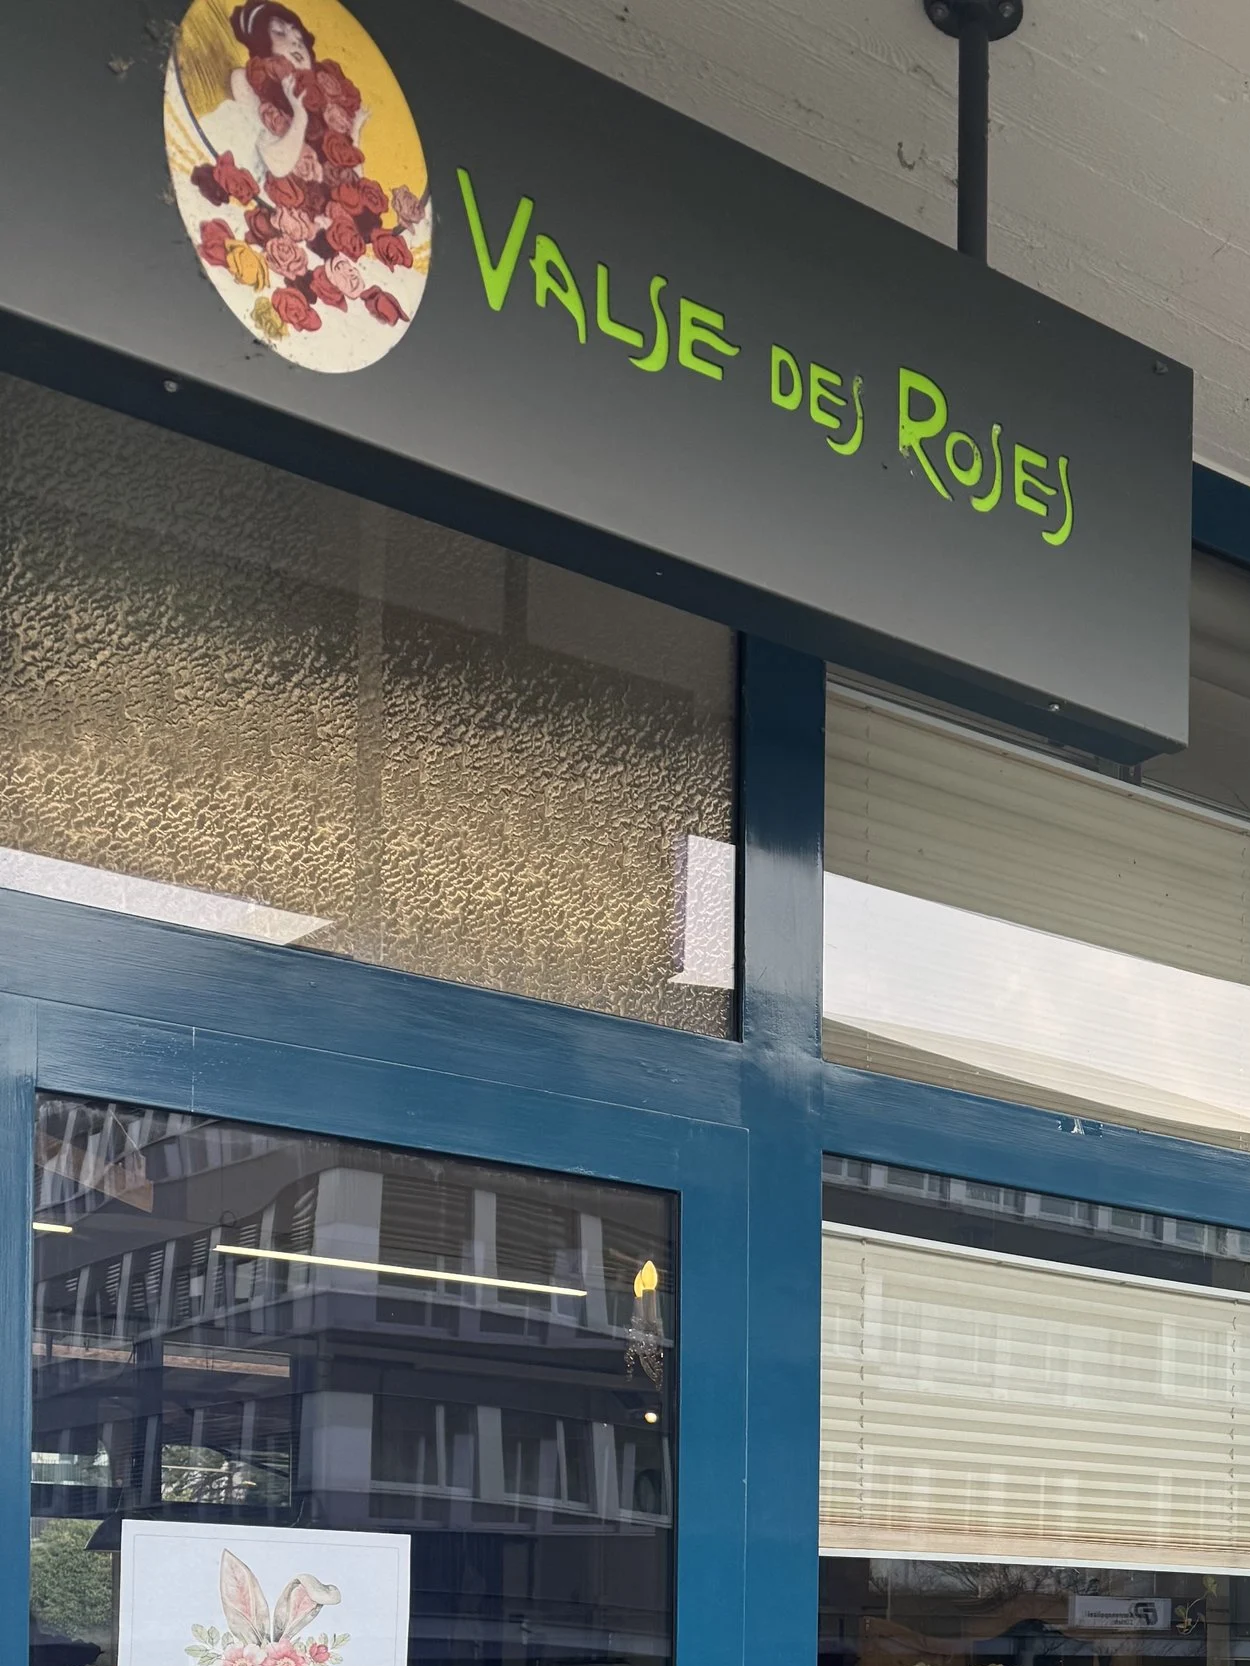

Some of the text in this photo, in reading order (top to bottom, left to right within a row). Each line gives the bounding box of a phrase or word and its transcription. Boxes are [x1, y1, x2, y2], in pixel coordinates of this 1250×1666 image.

[456, 167, 1075, 546] VALSE DES ROSES
